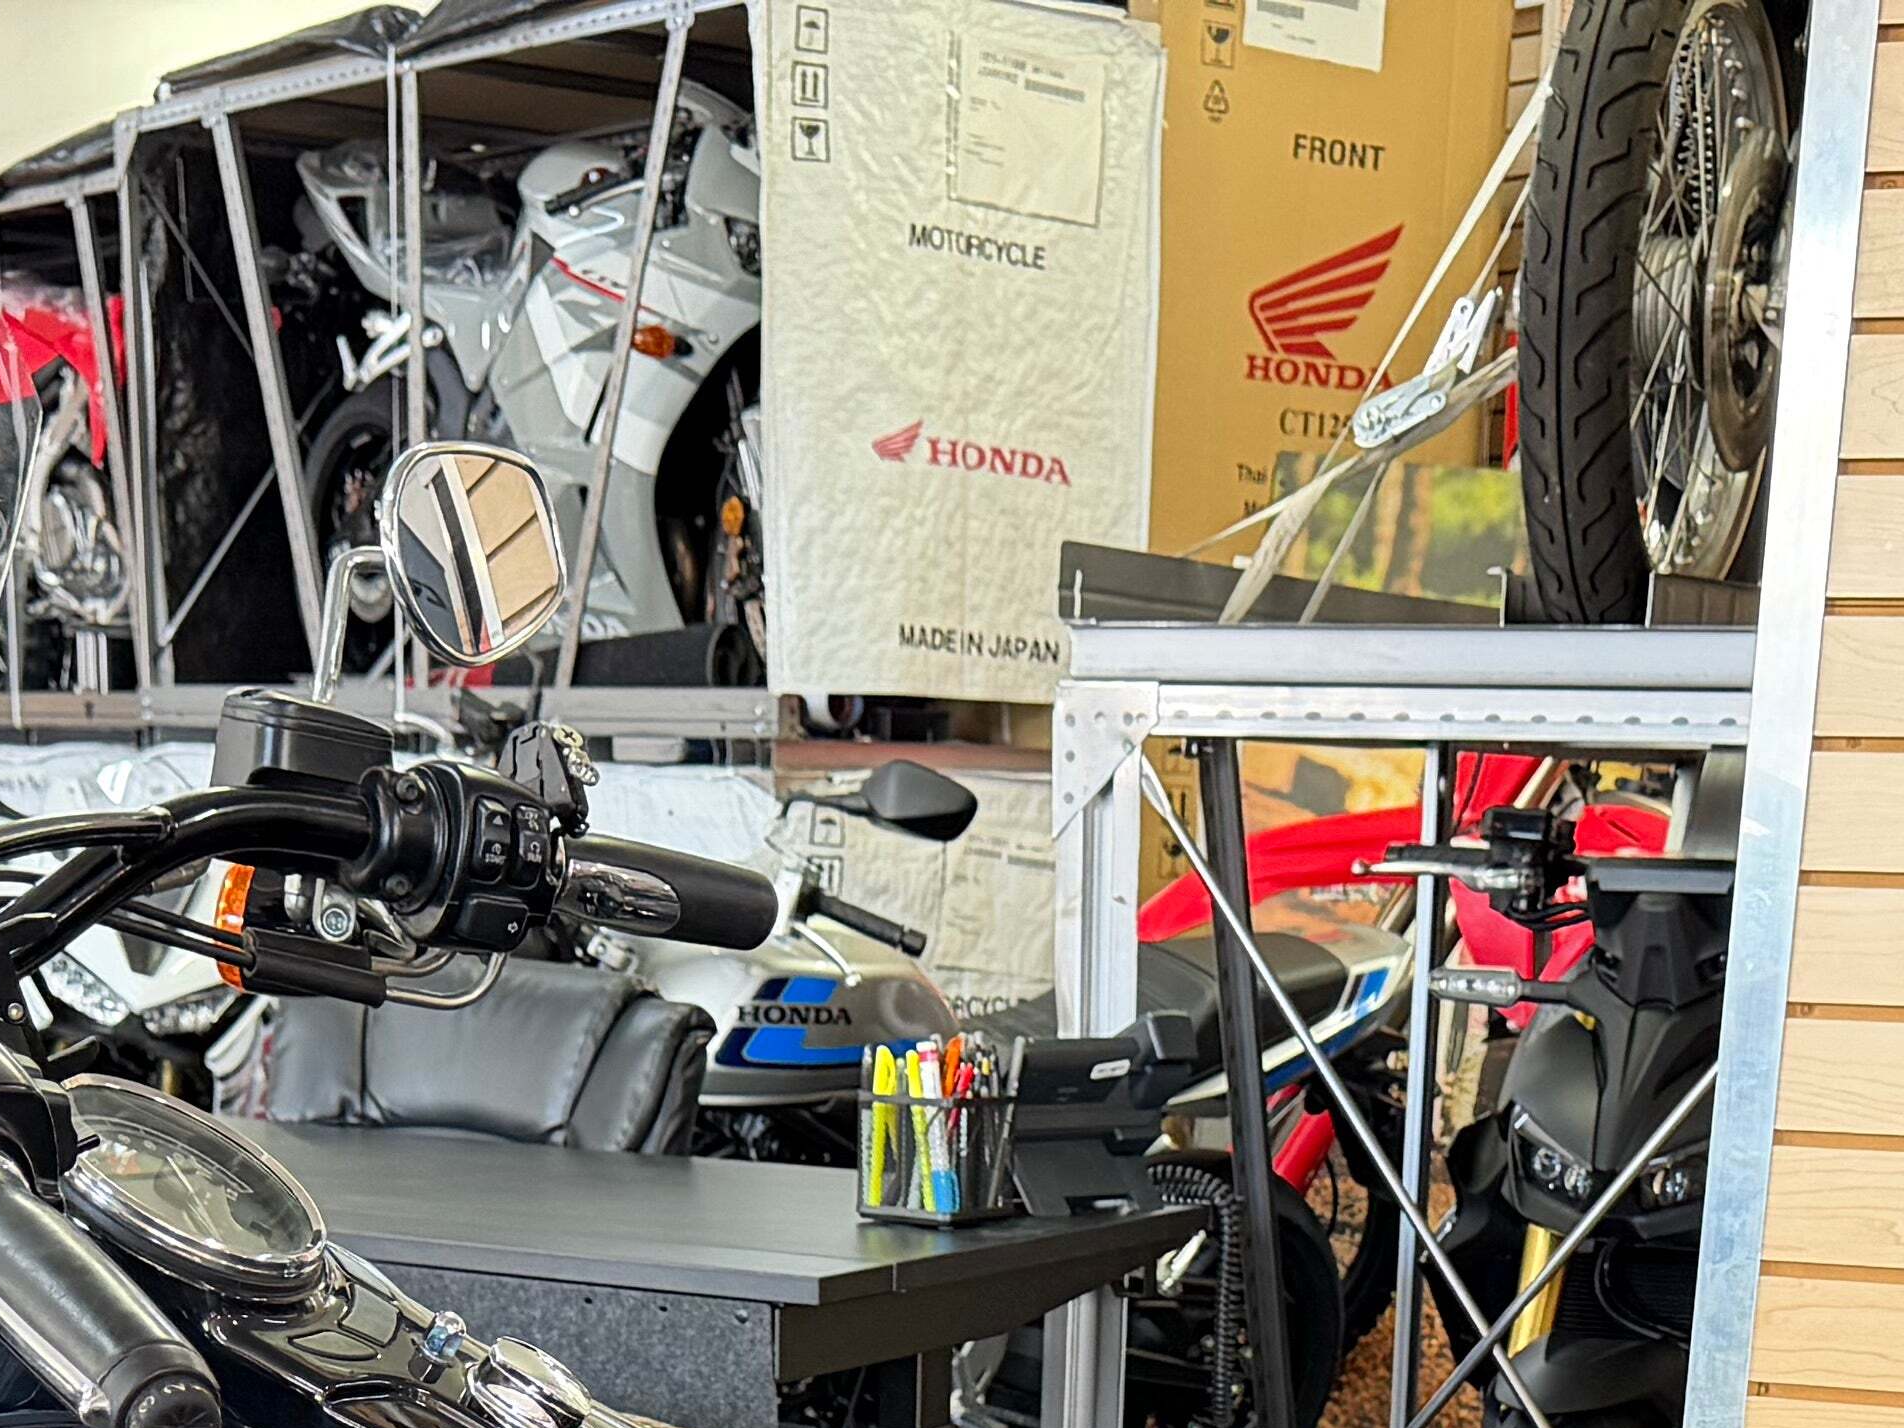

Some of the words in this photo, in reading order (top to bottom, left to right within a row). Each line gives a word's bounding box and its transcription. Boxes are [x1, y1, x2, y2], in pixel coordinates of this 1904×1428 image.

[1292, 133, 1386, 172] FRONT
[908, 222, 1047, 271] MOTORCYCLE
[1246, 354, 1395, 391] HONDA
[926, 435, 1073, 488] HONDA
[898, 622, 959, 657] MADE
[960, 629, 984, 658] IN
[987, 632, 1061, 666] JAPAN
[737, 1004, 853, 1026] HONDA
